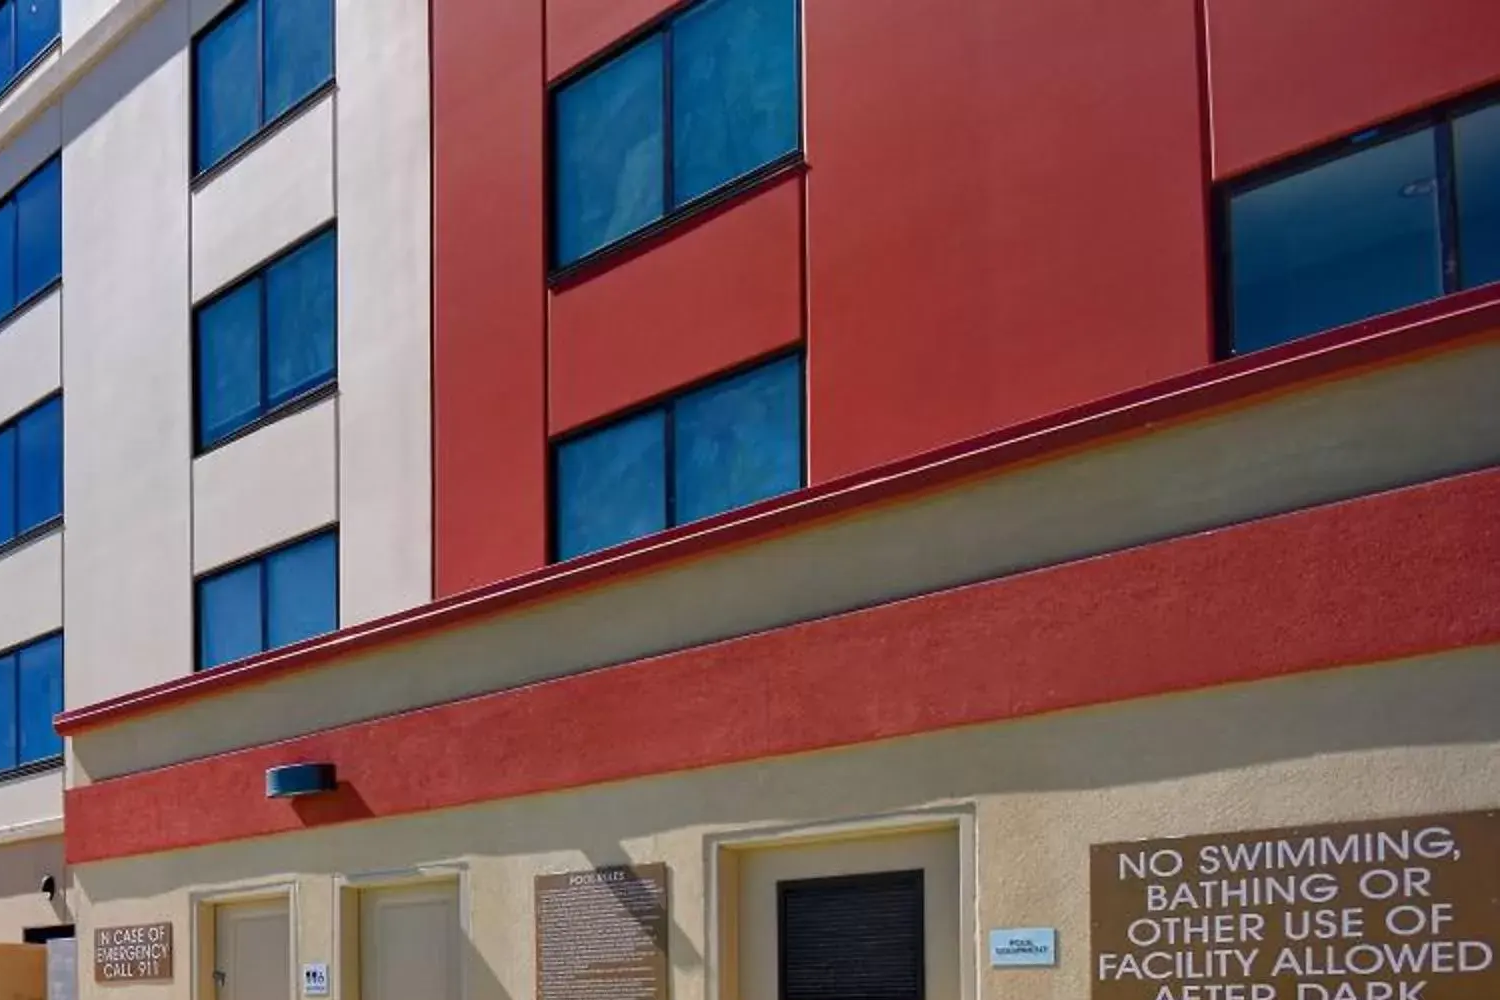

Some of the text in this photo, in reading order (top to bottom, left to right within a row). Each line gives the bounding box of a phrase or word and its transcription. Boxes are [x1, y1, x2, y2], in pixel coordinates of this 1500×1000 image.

[1119, 827, 1461, 880] NO SWIMMING,
[1147, 867, 1432, 912] BATHING OR
[113, 927, 144, 945] CASE
[148, 925, 165, 943] OF
[1127, 903, 1453, 946] OTHER USE OF
[97, 943, 170, 963] EMERGENCY
[103, 960, 160, 978] CALL 911
[1099, 940, 1493, 981] FACILITY ALLOWED
